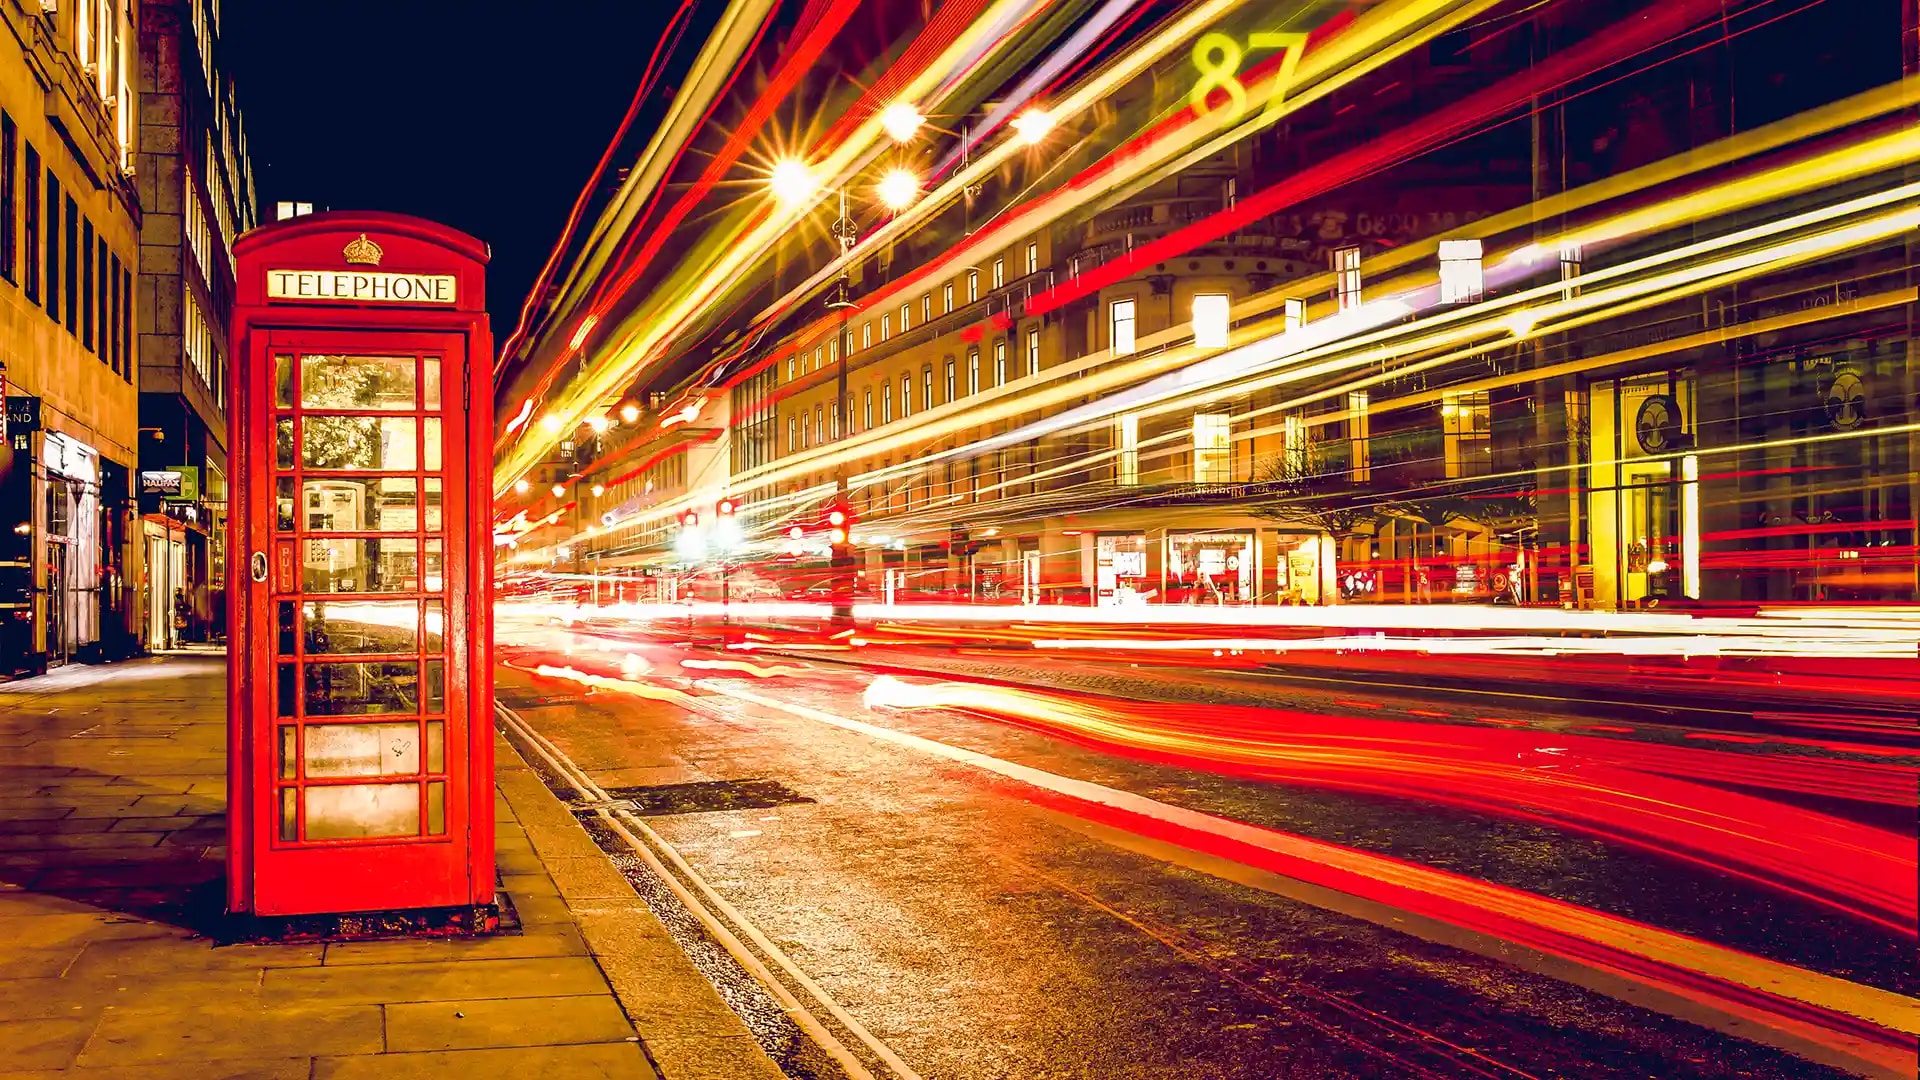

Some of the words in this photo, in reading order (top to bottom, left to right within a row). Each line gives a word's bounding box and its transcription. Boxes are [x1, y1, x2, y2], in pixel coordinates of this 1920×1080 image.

[1189, 31, 1309, 126] 87
[275, 273, 449, 300] TELEPHONE
[143, 479, 180, 487] HALIFAX
[282, 547, 290, 588] PULL
